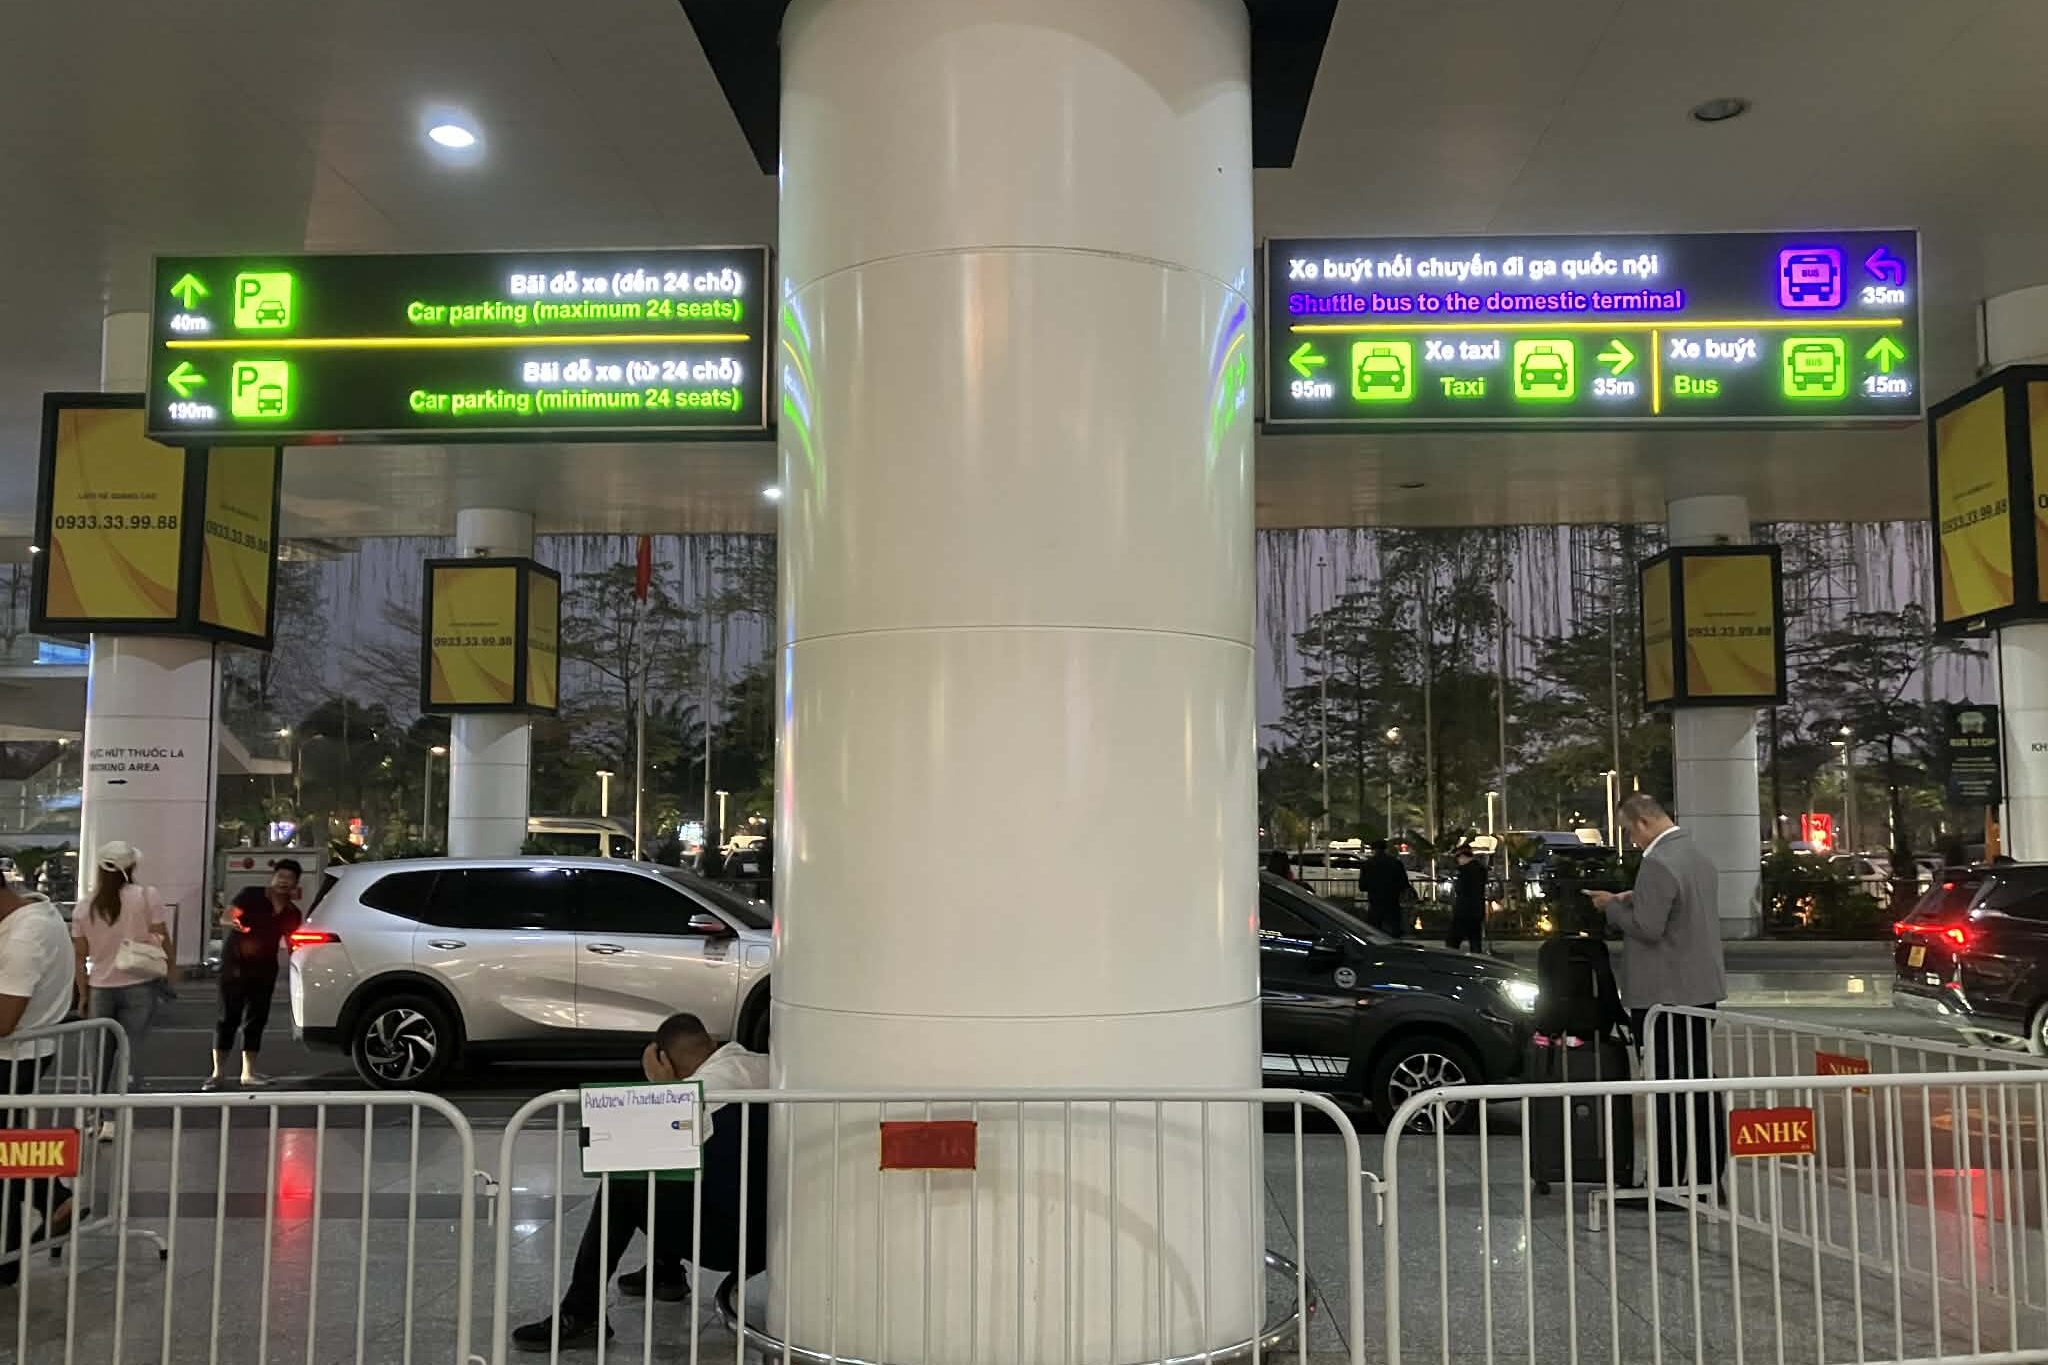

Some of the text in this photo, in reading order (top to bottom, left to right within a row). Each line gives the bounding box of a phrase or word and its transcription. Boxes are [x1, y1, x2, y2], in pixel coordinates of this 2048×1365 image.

[1289, 258, 1318, 278] Xe
[1324, 257, 1372, 282] buýt
[1378, 253, 1412, 278] nối
[1502, 256, 1523, 276] đi
[1528, 259, 1556, 280] ga
[1562, 251, 1618, 280] quốc
[1622, 254, 1658, 279] nội
[582, 277, 608, 294] xe
[664, 272, 690, 292] 24
[1289, 290, 1682, 313] Shuttle bus to the domestic terminal
[1863, 286, 1905, 304] 35m
[407, 298, 741, 326] Car parking (maximum 24 seats)
[170, 314, 208, 330] 40m
[1424, 338, 1500, 361] Xe taxi
[1670, 338, 1756, 362] Xe buýt
[596, 364, 622, 382] xe
[662, 360, 689, 381] 24
[1291, 380, 1332, 398] 95m
[1440, 376, 1486, 396] Taxi
[1593, 378, 1635, 396] 35m
[1674, 375, 1719, 394] Bus
[1864, 376, 1907, 394] 15m
[168, 402, 215, 420] 190m
[409, 387, 741, 416] Car parking (minimum 24 seats)
[55, 514, 178, 530] 0933.33.99.88
[128, 762, 160, 772] AREA
[584, 1091, 625, 1108] Andrew
[1737, 1120, 1808, 1145] ANHK
